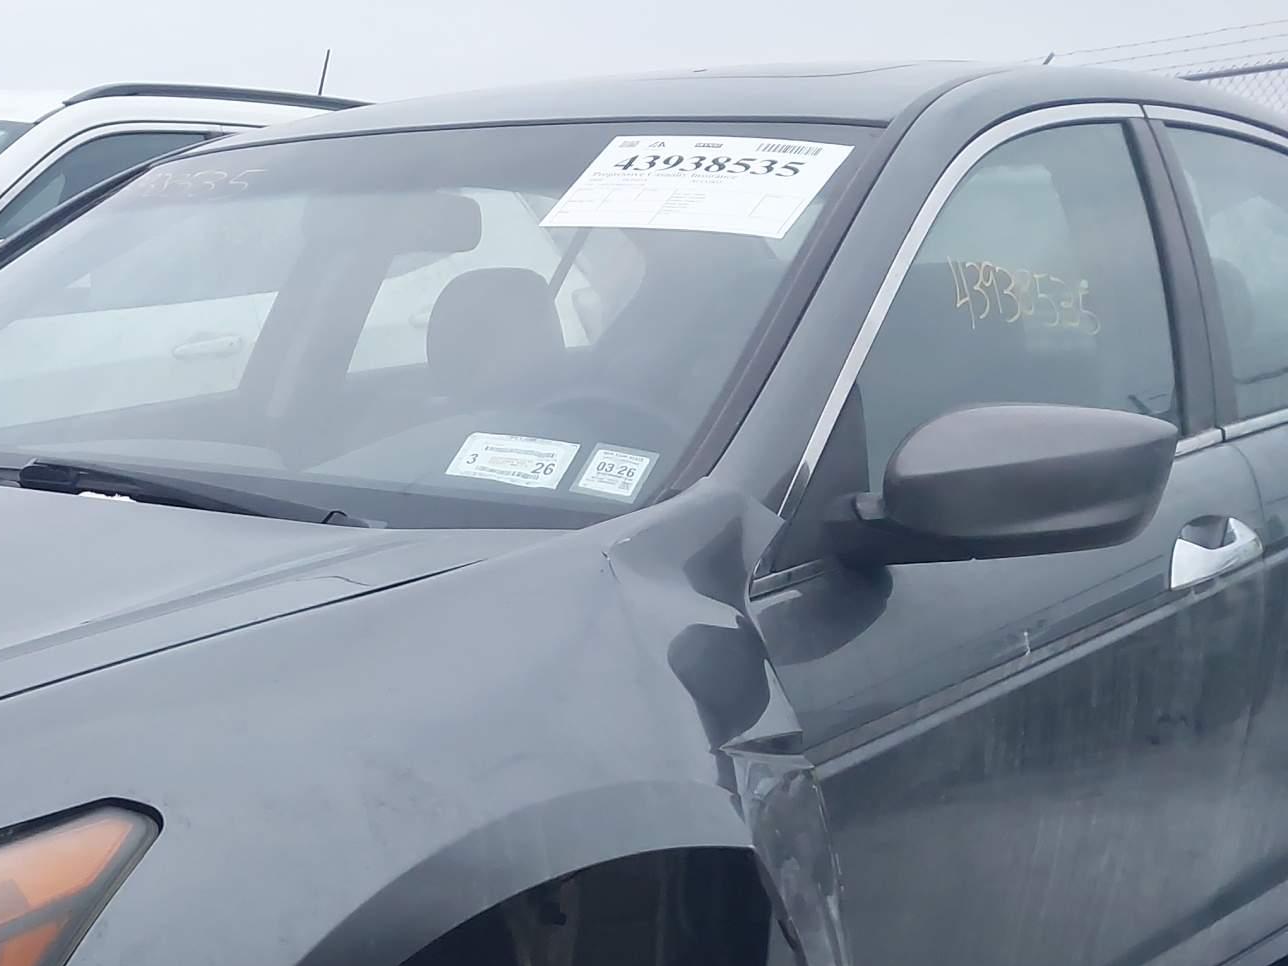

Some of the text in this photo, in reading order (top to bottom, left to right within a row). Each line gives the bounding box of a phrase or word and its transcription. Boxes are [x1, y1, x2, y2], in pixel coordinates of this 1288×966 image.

[614, 154, 807, 178] 43938535
[466, 453, 479, 465] 3
[531, 462, 556, 476] 26
[596, 461, 637, 478] 03 26
